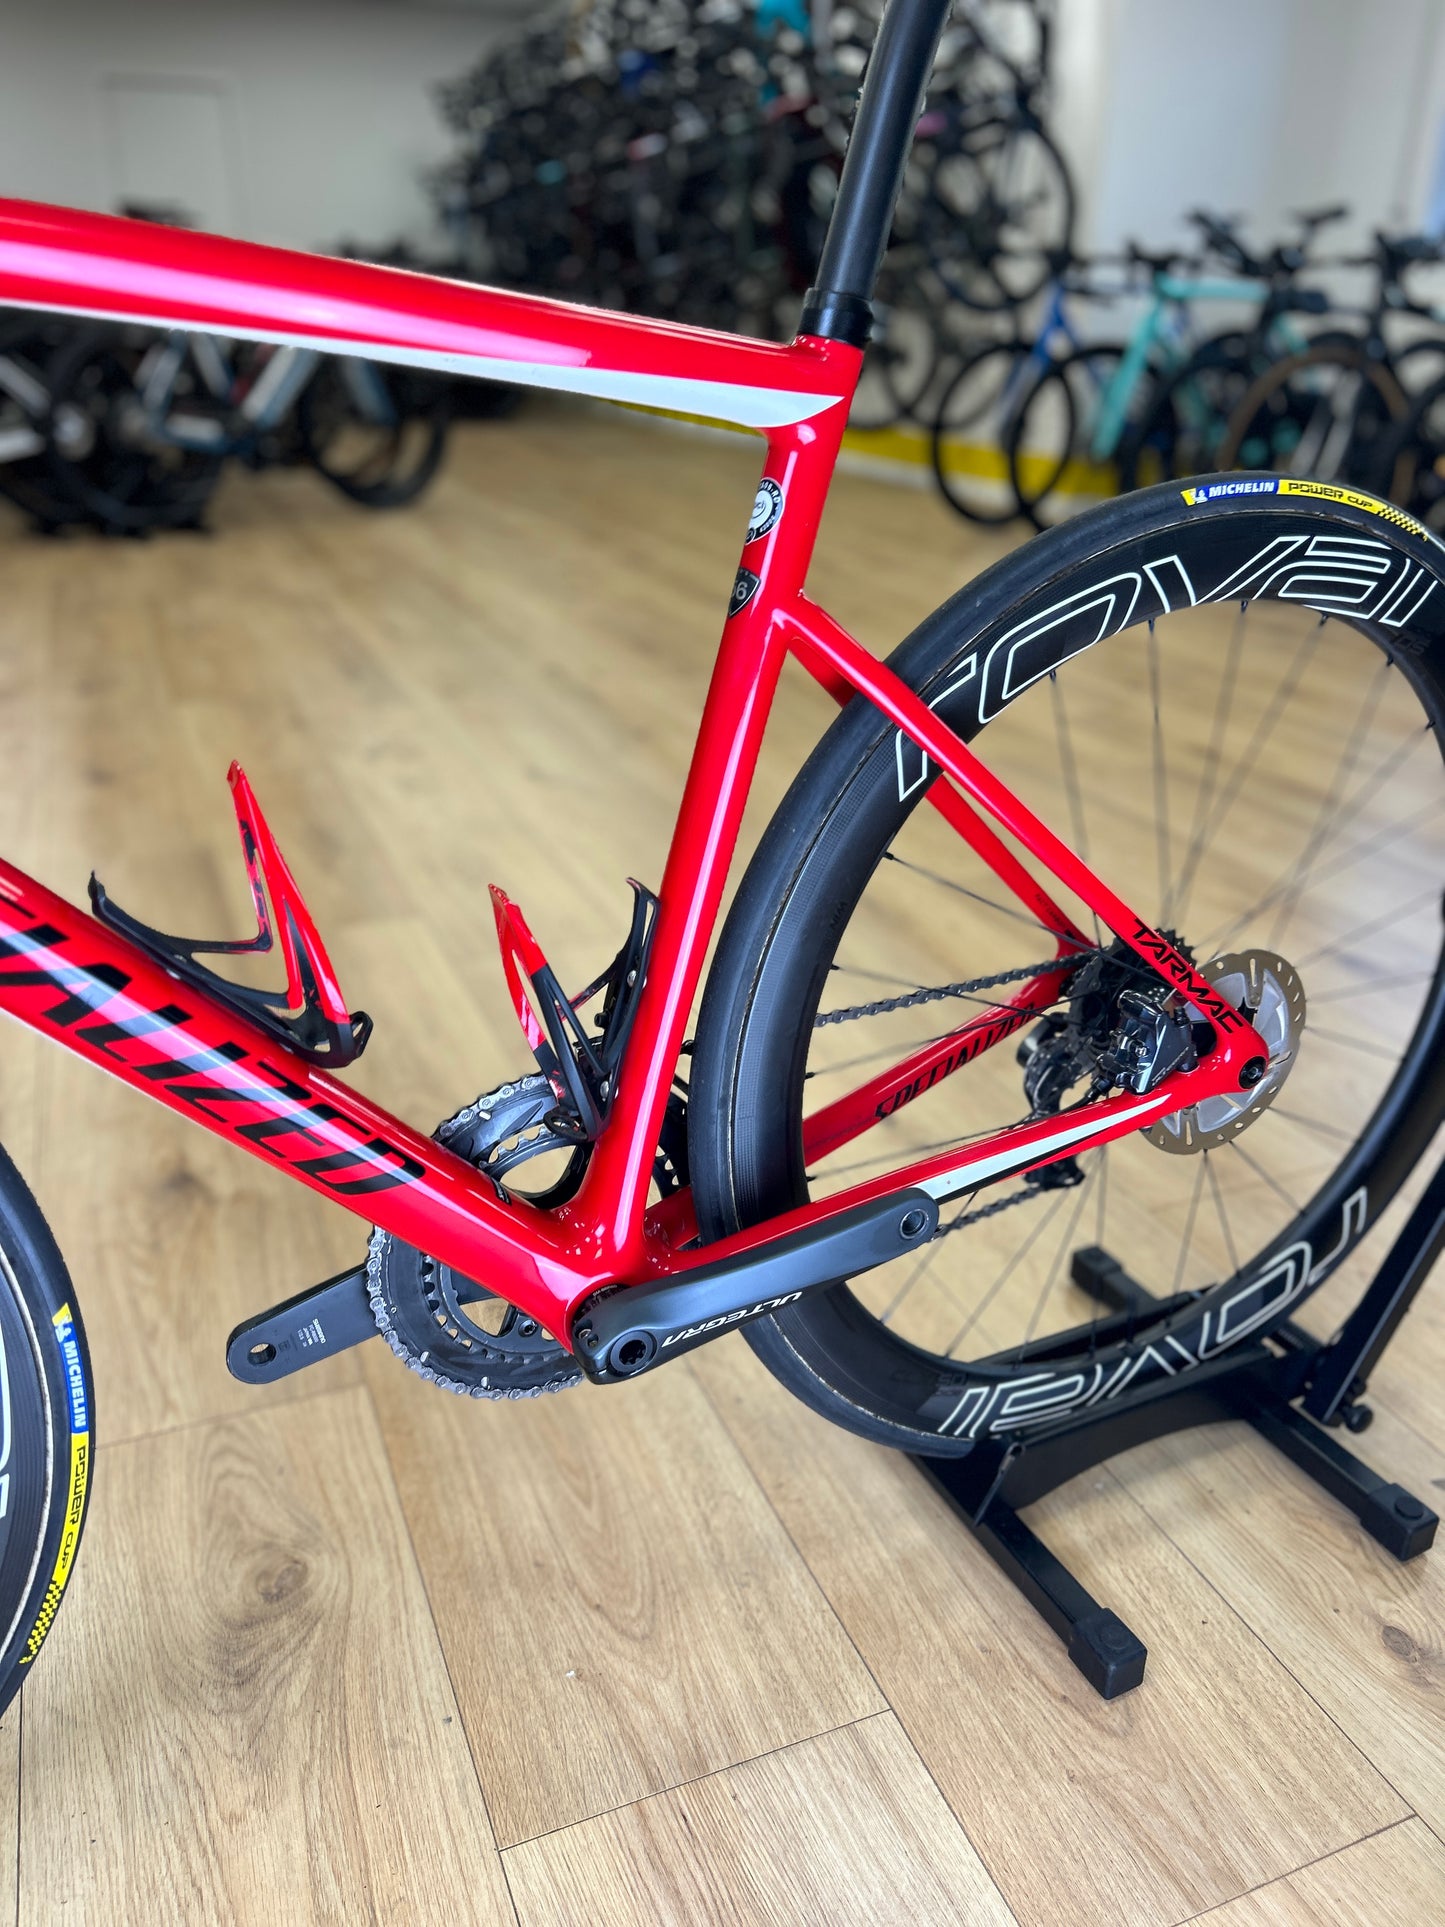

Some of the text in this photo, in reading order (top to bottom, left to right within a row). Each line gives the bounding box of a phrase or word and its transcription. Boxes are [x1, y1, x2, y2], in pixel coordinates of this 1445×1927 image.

[1209, 481, 1374, 508] MICHELIN POWER CUP
[1132, 918, 1245, 1035] TARMAC
[662, 1290, 804, 1348] ULTEGRA
[63, 1341, 86, 1428] MICHELIN
[61, 1444, 86, 1570] POWER CUP
